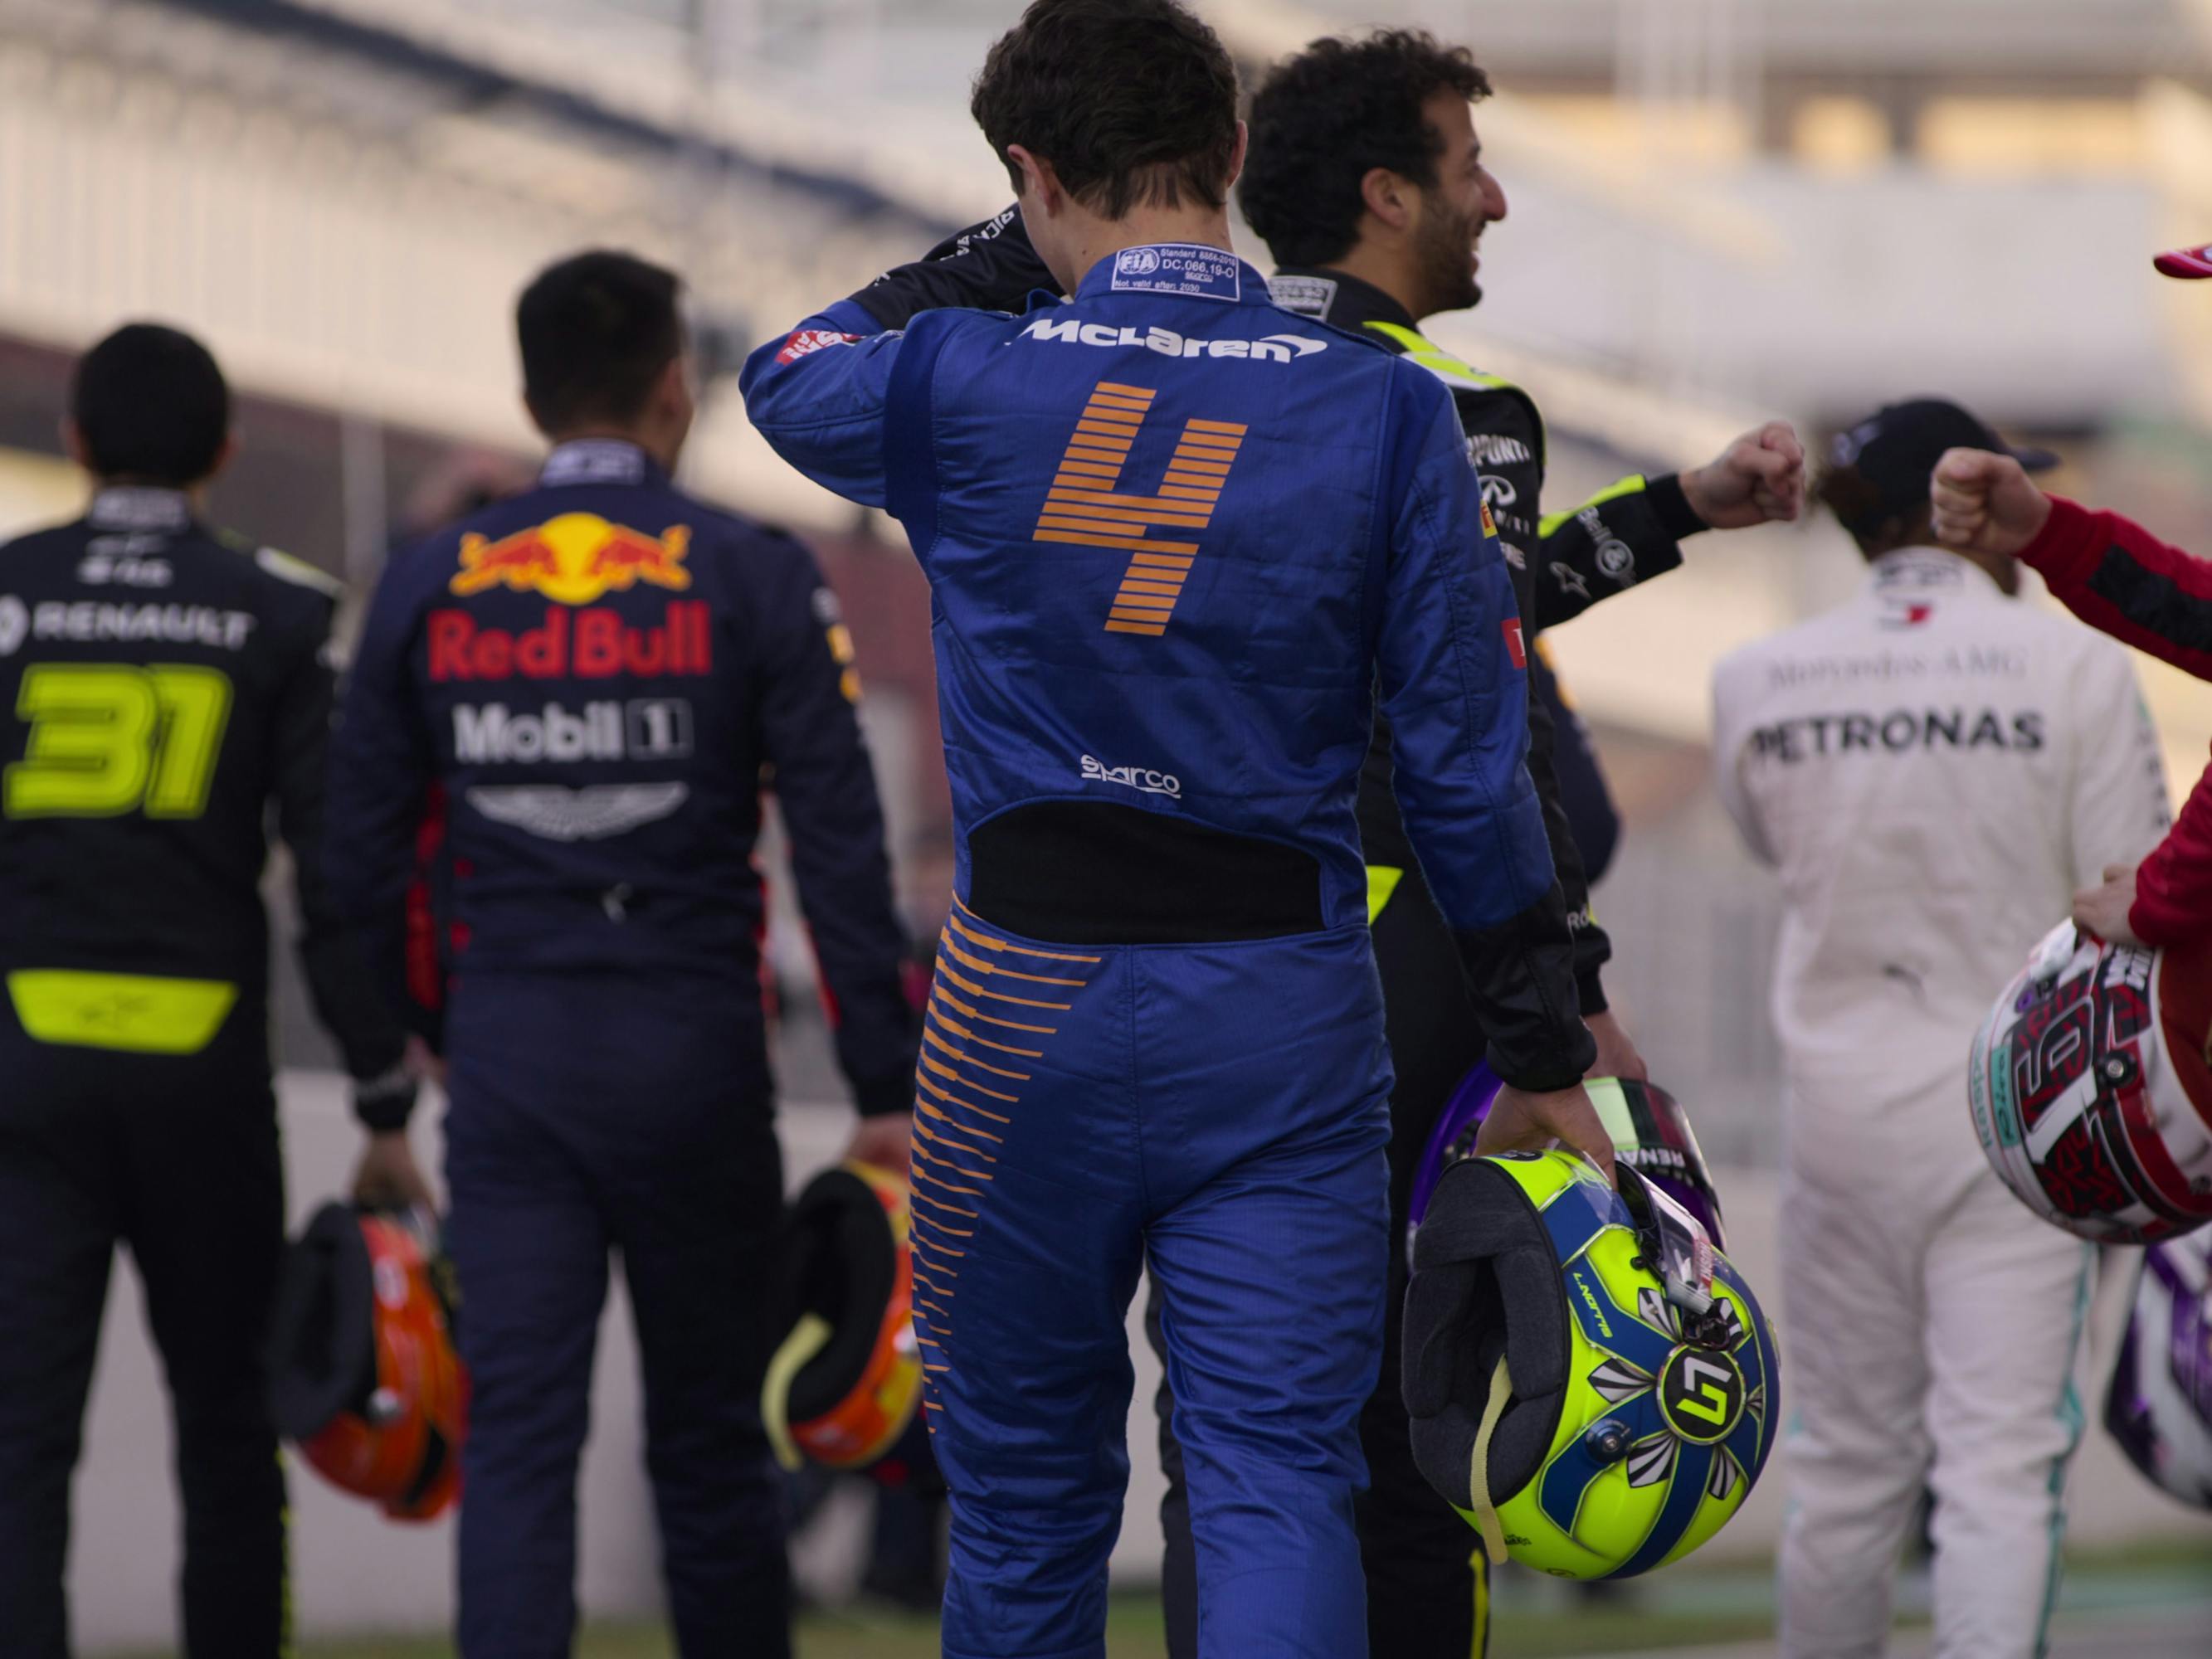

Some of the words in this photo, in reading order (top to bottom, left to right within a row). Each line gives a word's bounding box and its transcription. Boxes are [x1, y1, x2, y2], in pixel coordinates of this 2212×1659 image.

[1161, 249, 1196, 259] Standard
[1016, 319, 1328, 363] McLaren
[1032, 381, 1249, 636] 4
[32, 601, 255, 650] RENAULT
[427, 606, 569, 681] Red
[573, 600, 712, 679] Bull
[3, 663, 234, 820] 31
[451, 700, 625, 763] Mobil
[1751, 703, 2045, 763] PETRONAS
[1615, 1147, 1687, 1169] RENA
